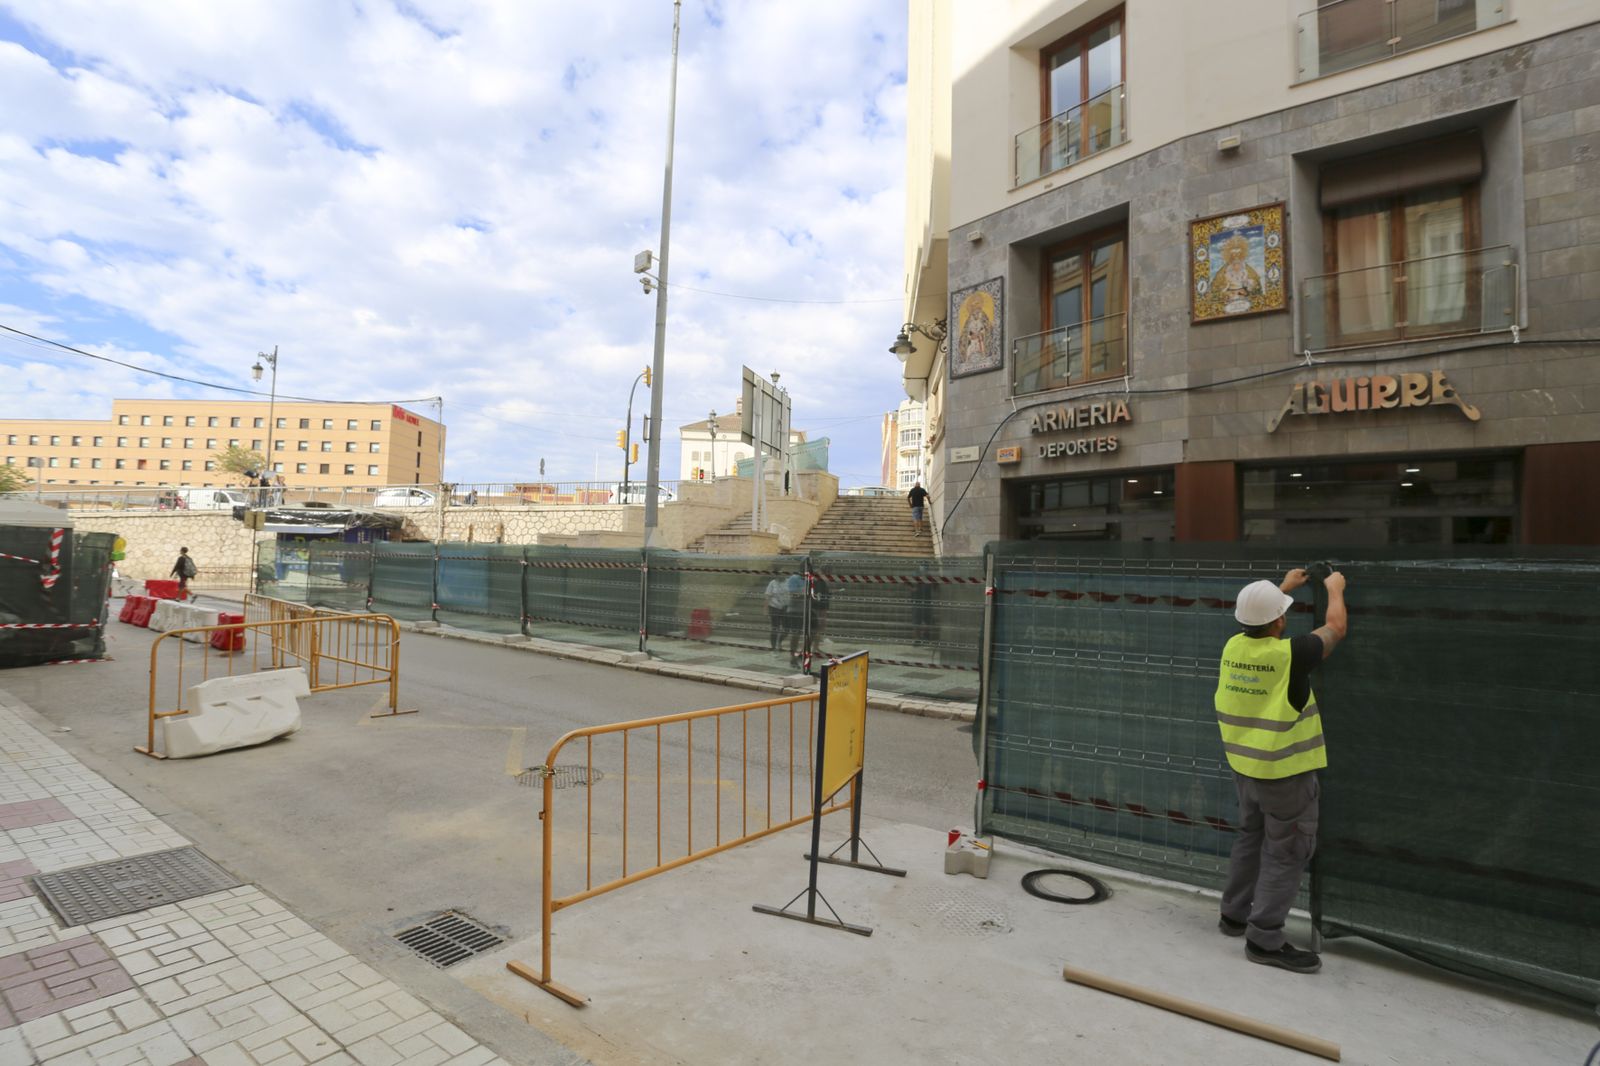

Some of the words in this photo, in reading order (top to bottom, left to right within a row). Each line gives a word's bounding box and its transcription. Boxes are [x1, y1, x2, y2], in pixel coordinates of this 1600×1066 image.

[1030, 399, 1131, 433] ARMERIA
[1038, 435, 1118, 459] DEPORTES
[1231, 661, 1276, 672] CARRETERÍA
